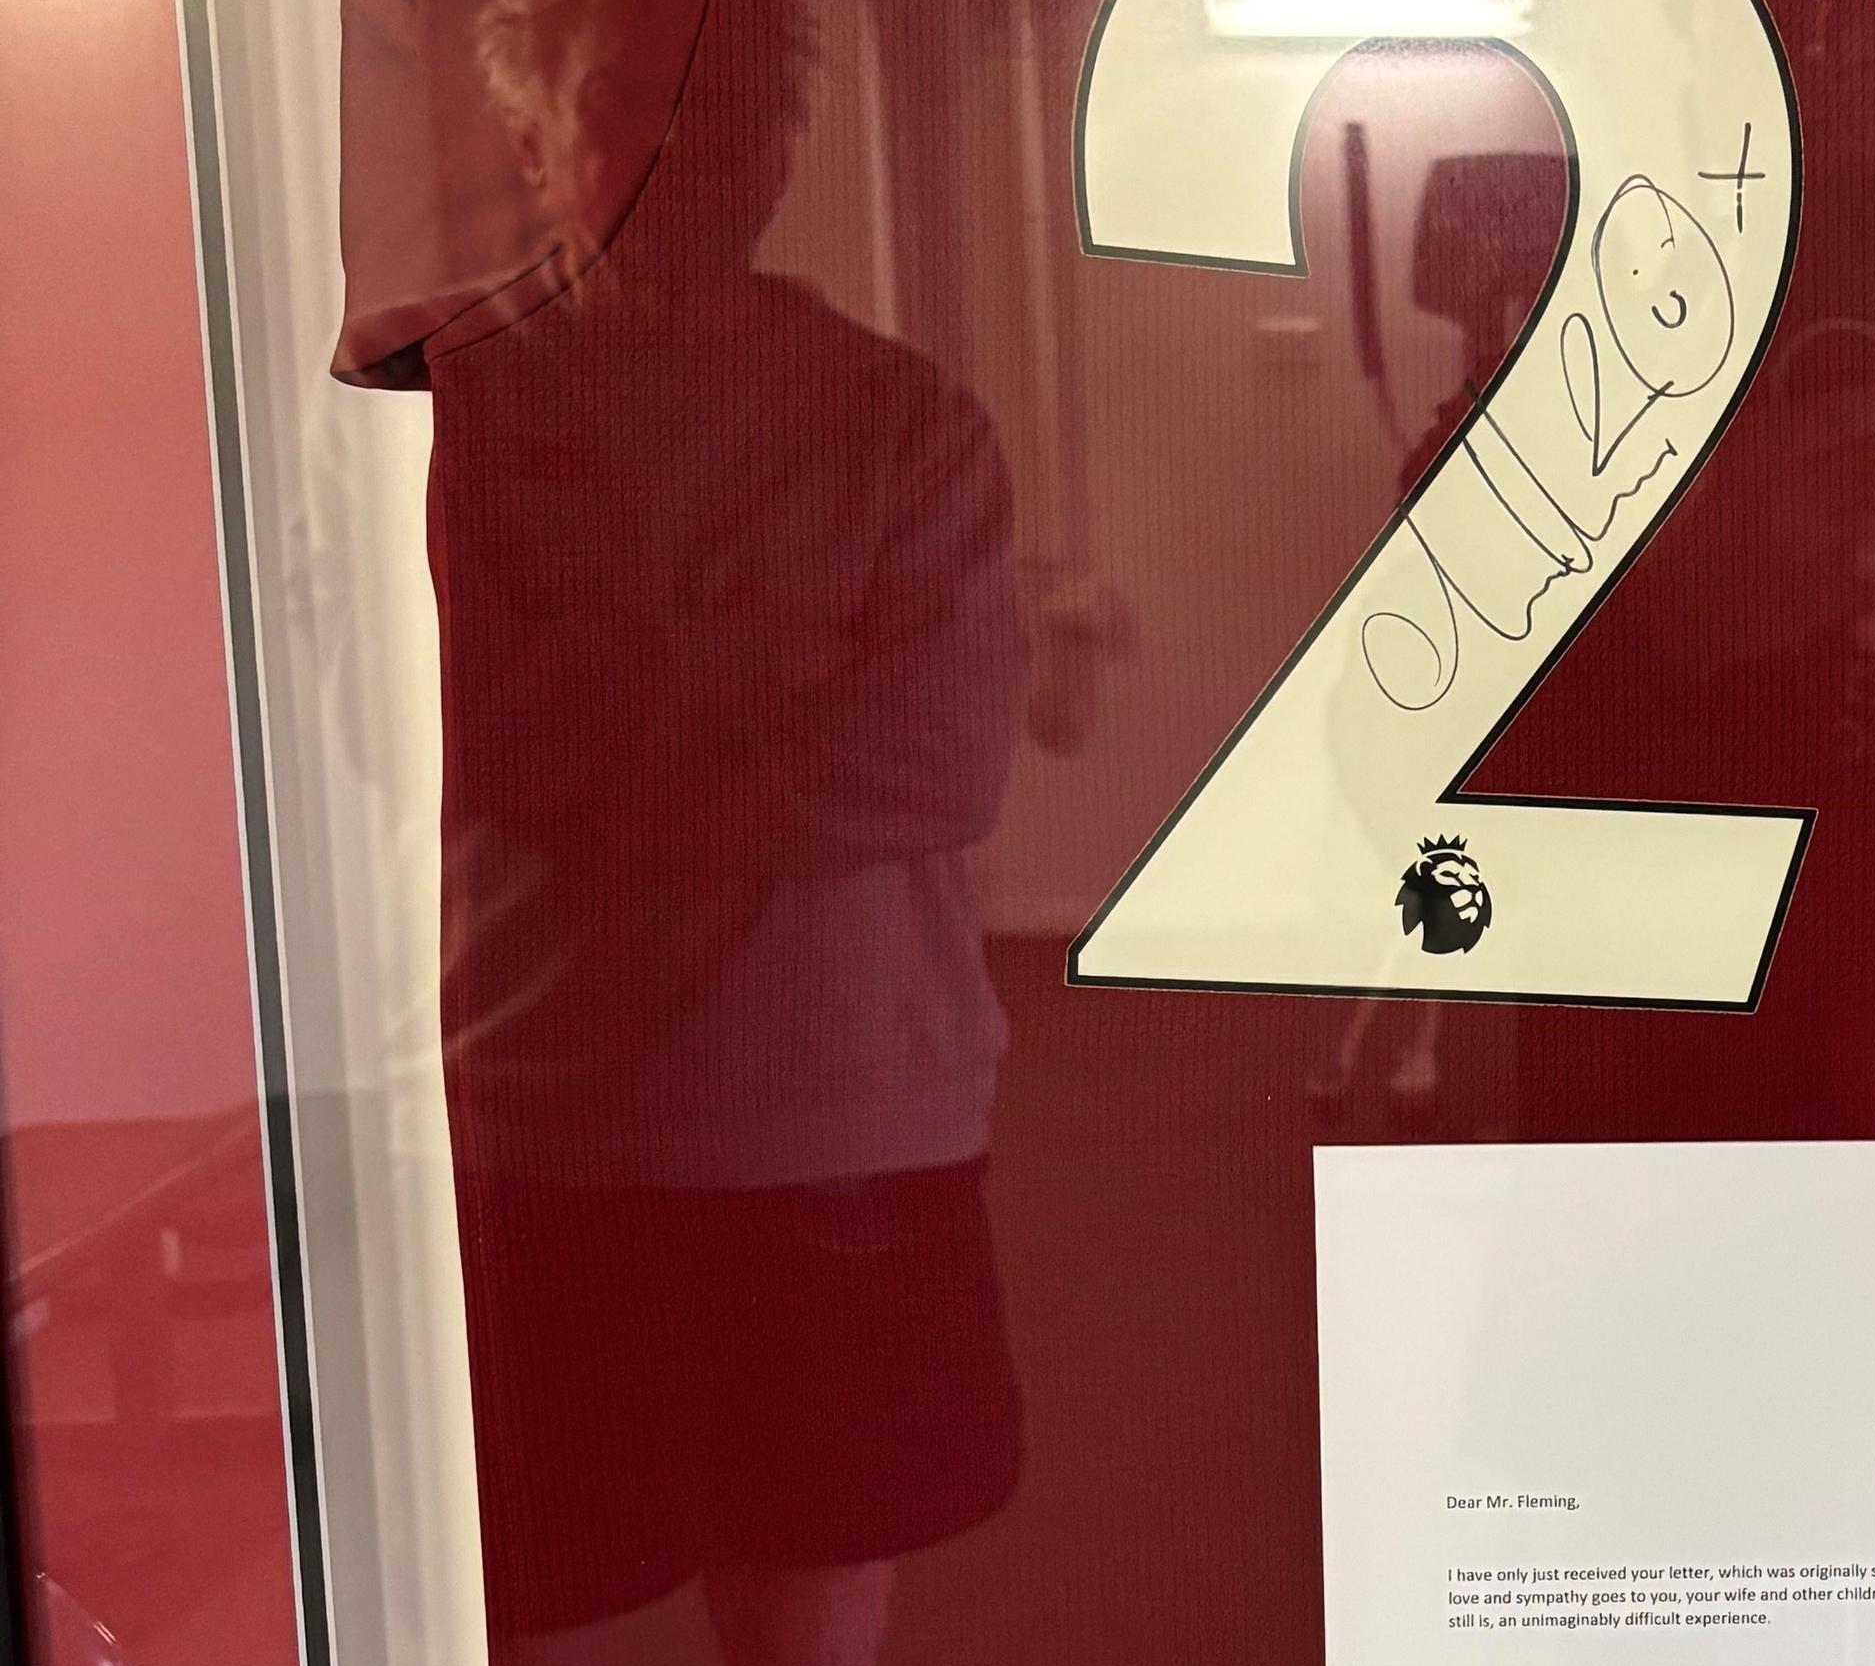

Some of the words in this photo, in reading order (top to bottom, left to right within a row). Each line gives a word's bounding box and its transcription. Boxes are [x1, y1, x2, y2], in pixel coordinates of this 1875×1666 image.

[1447, 1496, 1483, 1509] Dear
[1487, 1496, 1513, 1509] Mr.
[1518, 1494, 1582, 1511] Fleming,
[1448, 1569, 1452, 1581] I
[1457, 1568, 1492, 1582] have
[1497, 1568, 1528, 1584] only
[1531, 1568, 1560, 1584] just
[1564, 1566, 1626, 1580] received
[1631, 1569, 1665, 1583] your
[1670, 1566, 1714, 1581] letter,
[1718, 1565, 1762, 1579] which
[1767, 1568, 1796, 1578] was
[1800, 1563, 1868, 1581] originally
[1449, 1614, 1474, 1628] still
[1479, 1614, 1494, 1629] is,
[1498, 1617, 1518, 1627] an
[1522, 1613, 1621, 1629] unimaginably
[1625, 1612, 1681, 1625] difficult
[1685, 1611, 1771, 1627] experience.
